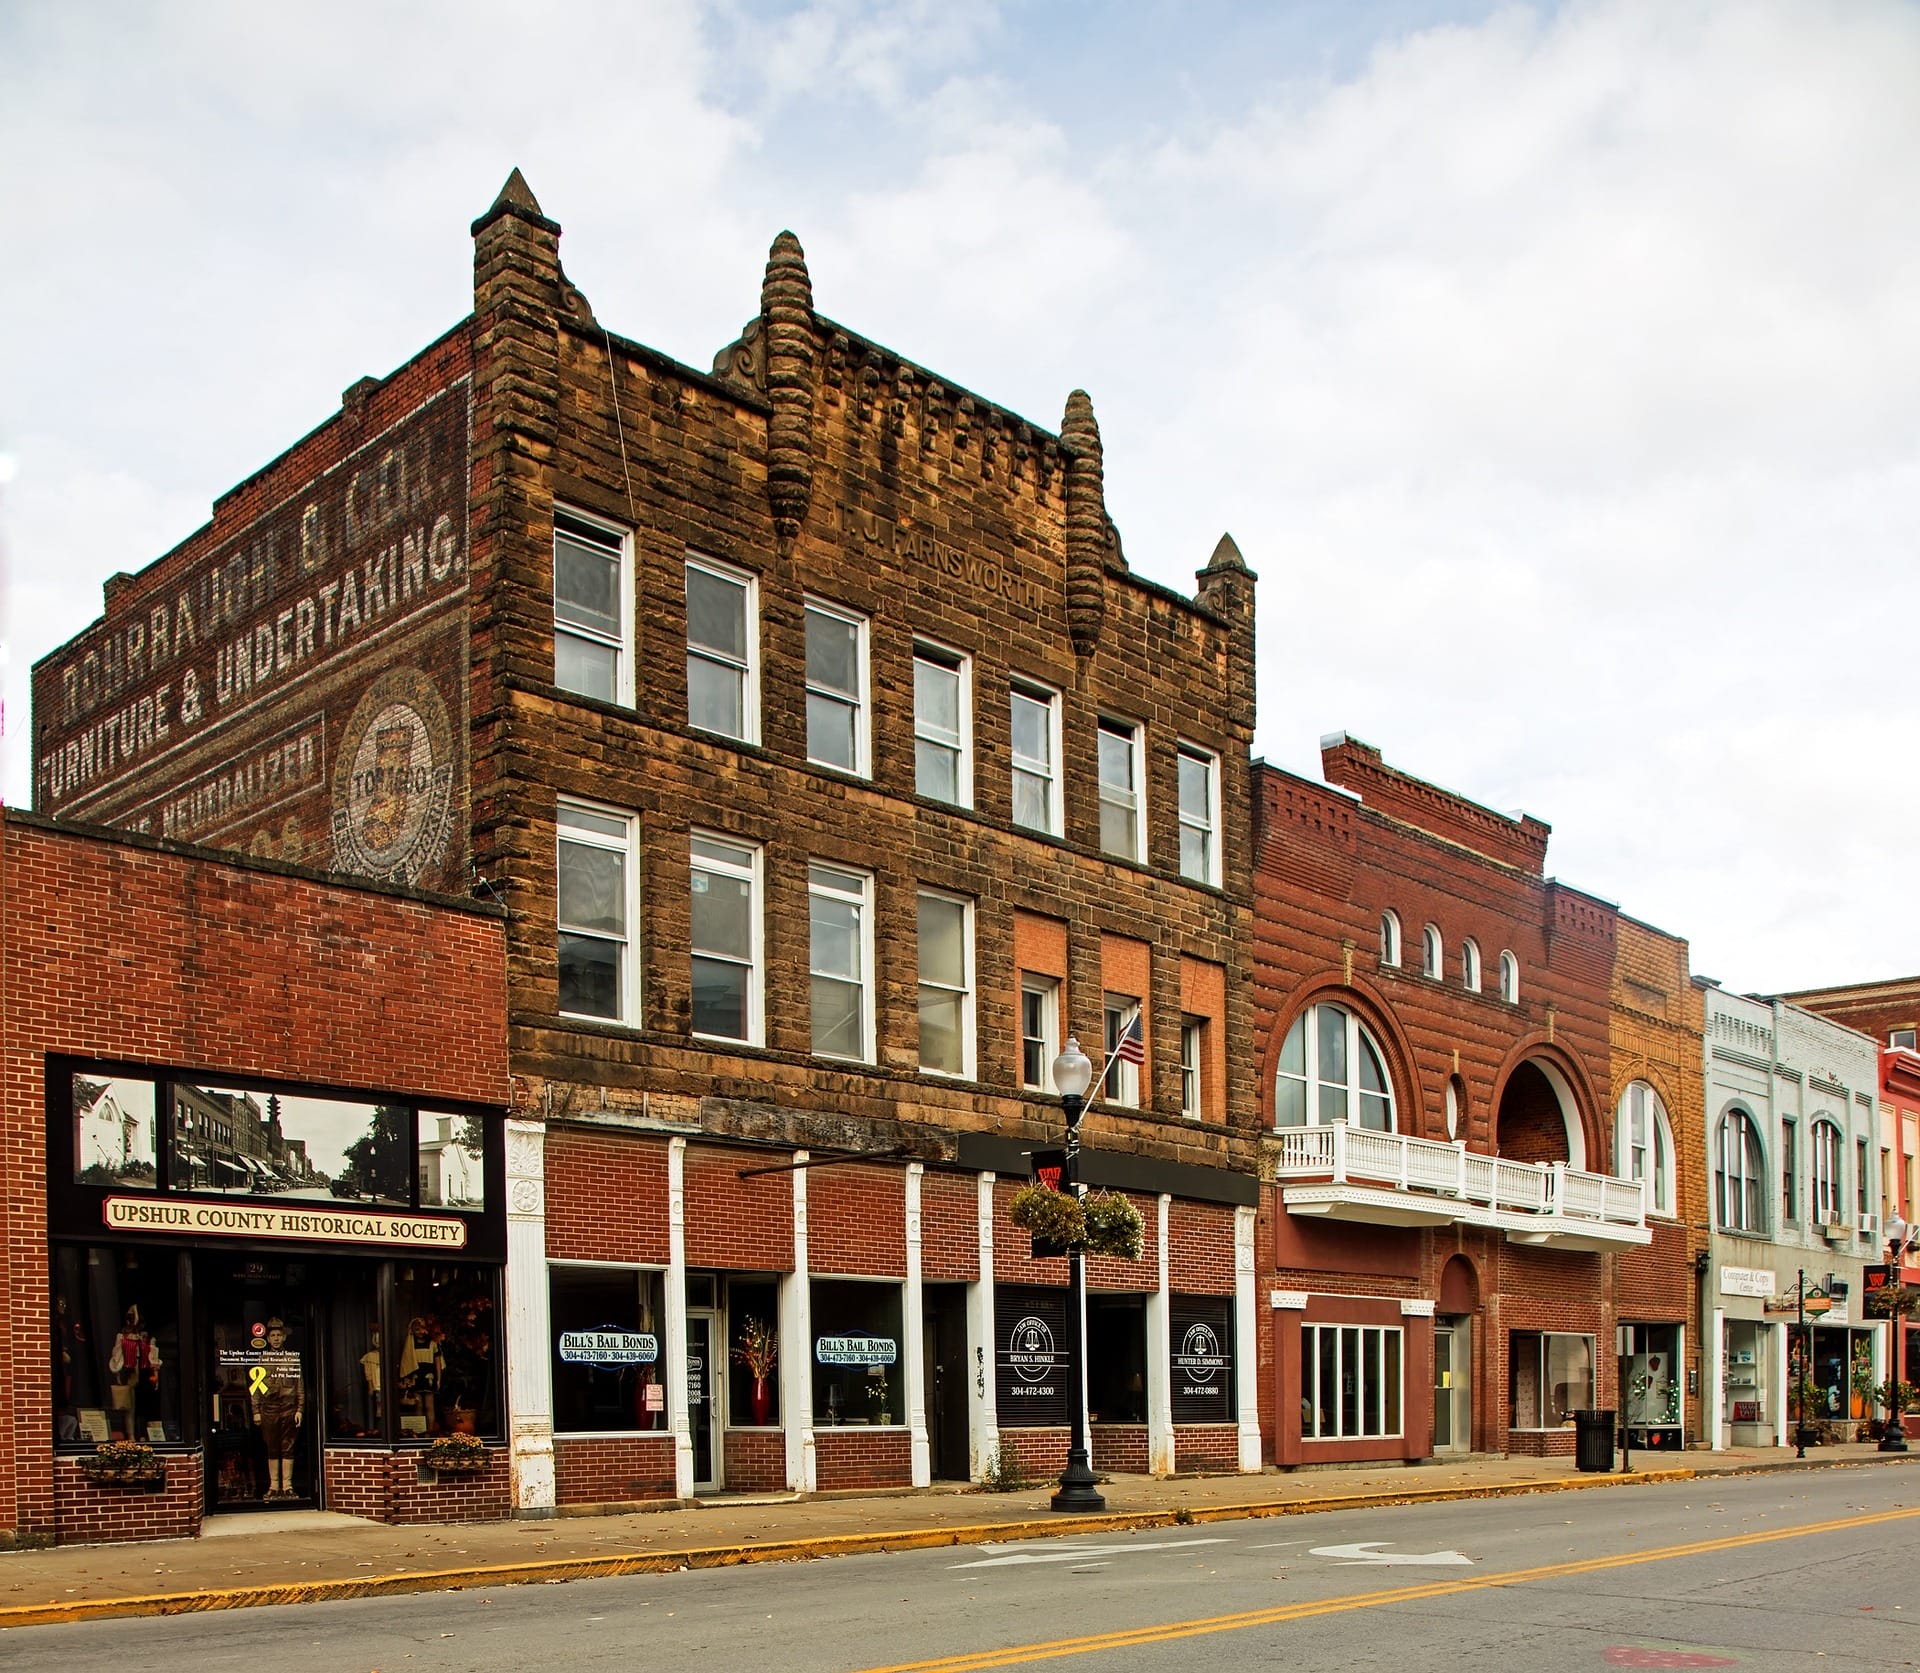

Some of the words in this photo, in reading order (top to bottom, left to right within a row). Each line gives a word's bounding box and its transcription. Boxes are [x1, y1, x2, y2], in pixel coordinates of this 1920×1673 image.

[180, 667, 202, 727] &
[216, 511, 466, 704] UNDERTAKING.
[111, 1204, 193, 1225] UPSHUR
[196, 1209, 276, 1230] COUNTY
[280, 1215, 387, 1237] HISTORICAL
[390, 1222, 461, 1241] SOCIETY
[597, 1334, 620, 1349] BAIL
[622, 1335, 655, 1349] BONDS
[847, 1339, 865, 1352] BAIL
[867, 1340, 894, 1352] BONDS
[1010, 1354, 1029, 1363] BRYAN
[1034, 1355, 1055, 1363] HINKLE
[1011, 1386, 1055, 1396] 304-472-4300
